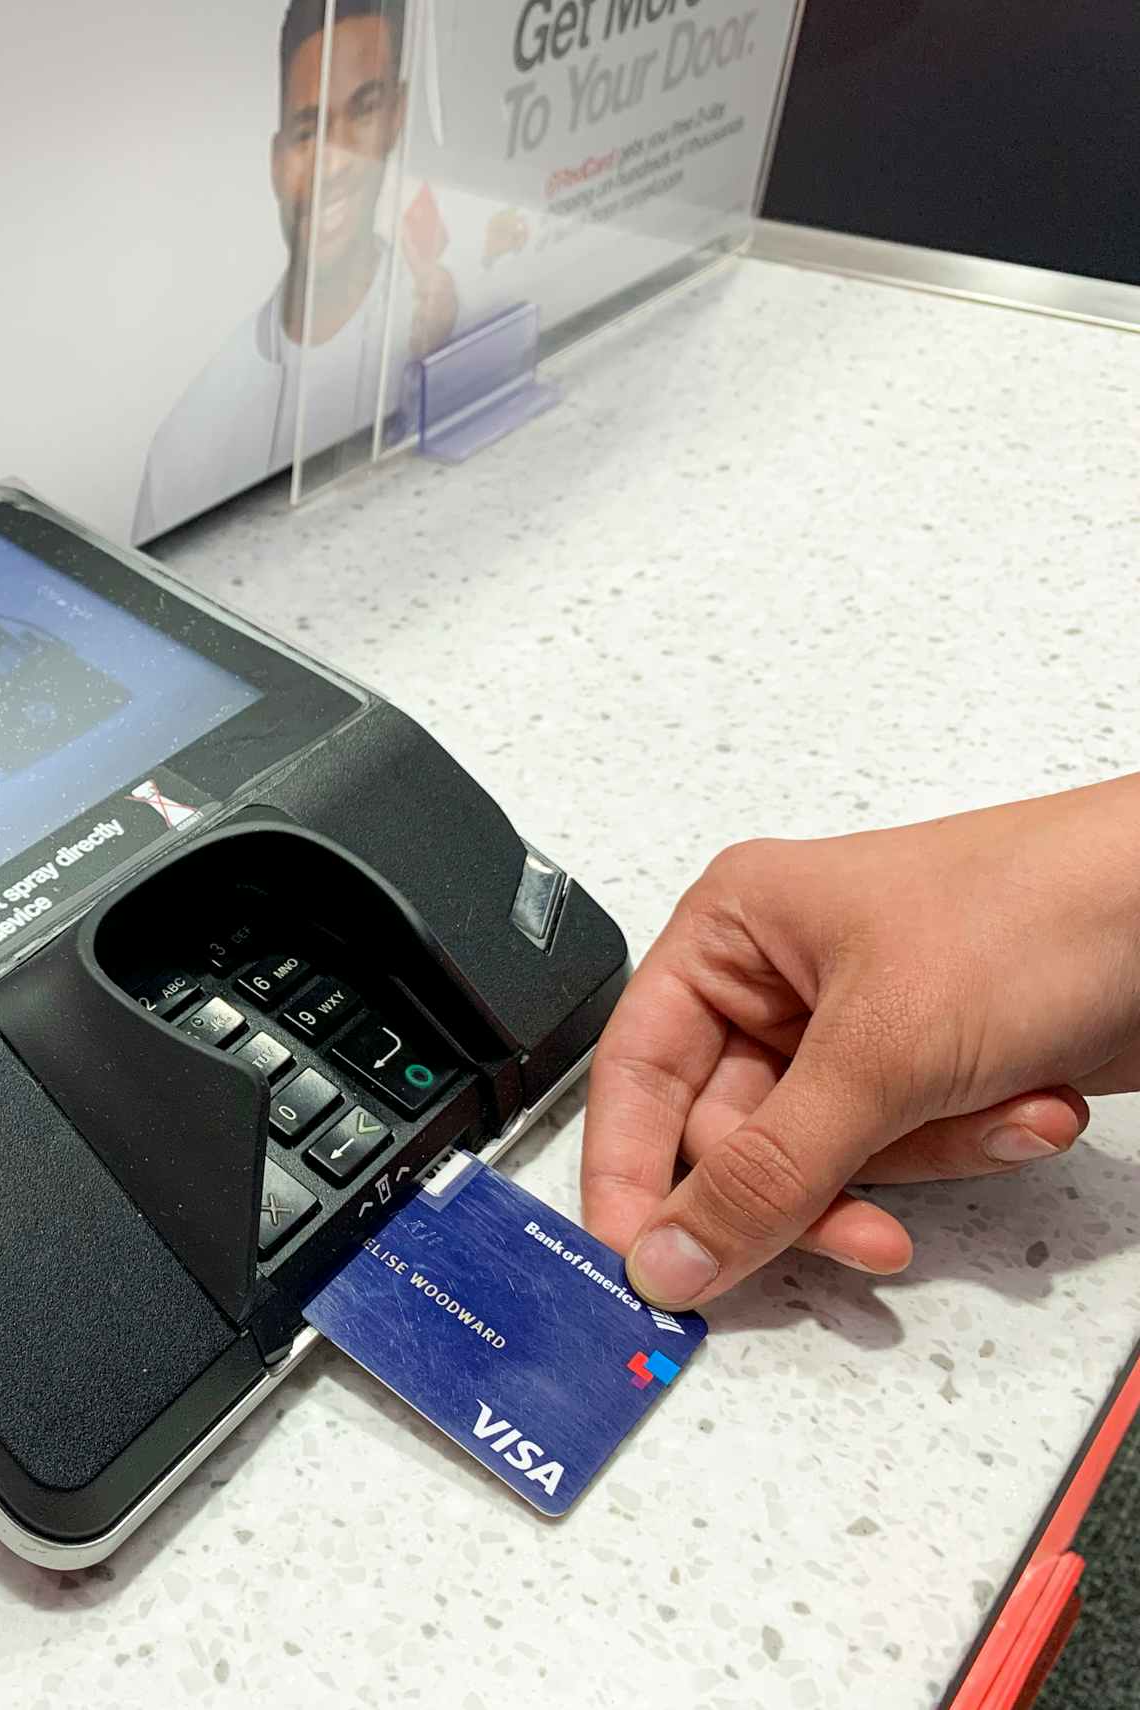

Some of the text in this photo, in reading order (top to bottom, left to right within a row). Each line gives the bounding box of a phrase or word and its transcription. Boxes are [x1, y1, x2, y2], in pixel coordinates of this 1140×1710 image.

[504, 80, 552, 160] To
[567, 48, 659, 134] Your
[662, 8, 758, 93] Door.
[3, 860, 60, 900] spray
[55, 818, 125, 868] directly
[161, 976, 187, 999] ABC
[210, 942, 226, 956] 3
[253, 958, 299, 991] 6 MNO
[298, 990, 347, 1026] 9 WXY
[362, 1238, 507, 1350] ELISE WOODWARD
[523, 1221, 642, 1312] Bank of America
[474, 1399, 566, 1497] VISA
